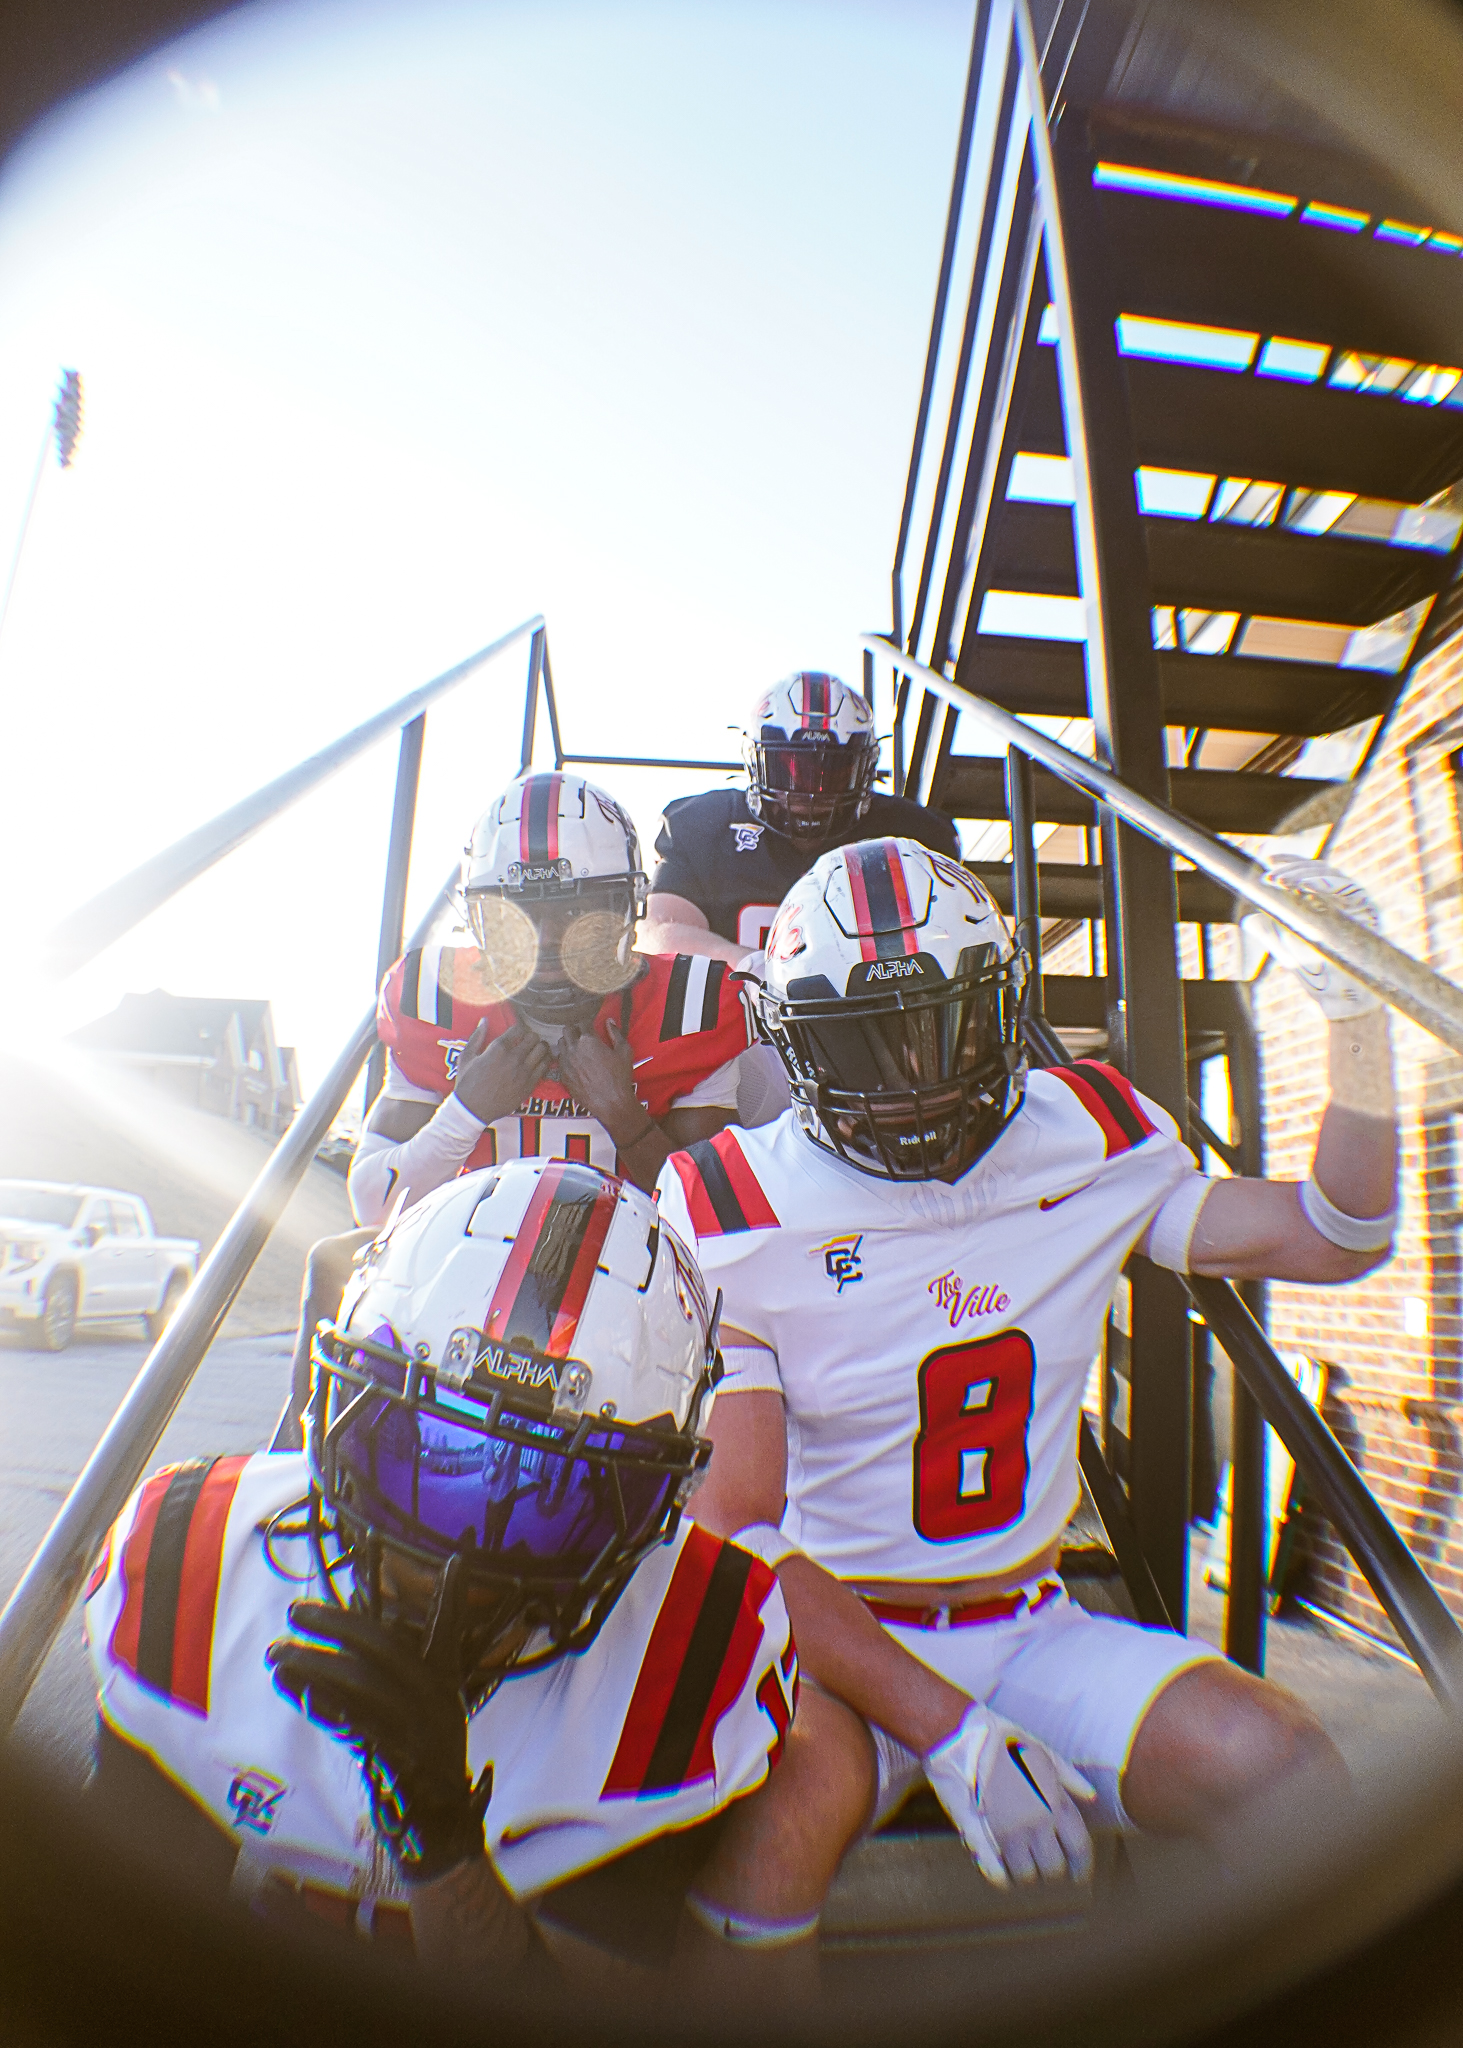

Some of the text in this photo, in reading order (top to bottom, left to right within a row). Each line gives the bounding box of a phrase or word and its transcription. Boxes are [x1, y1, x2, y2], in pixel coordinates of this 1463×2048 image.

[521, 866, 561, 881] ALPHA
[866, 958, 924, 982] ALPHA
[899, 1130, 937, 1146] Ridell
[928, 1269, 963, 1308] The
[943, 1283, 1012, 1328] Ville
[472, 1345, 560, 1392] ALPHA
[913, 1327, 1036, 1546] 8
